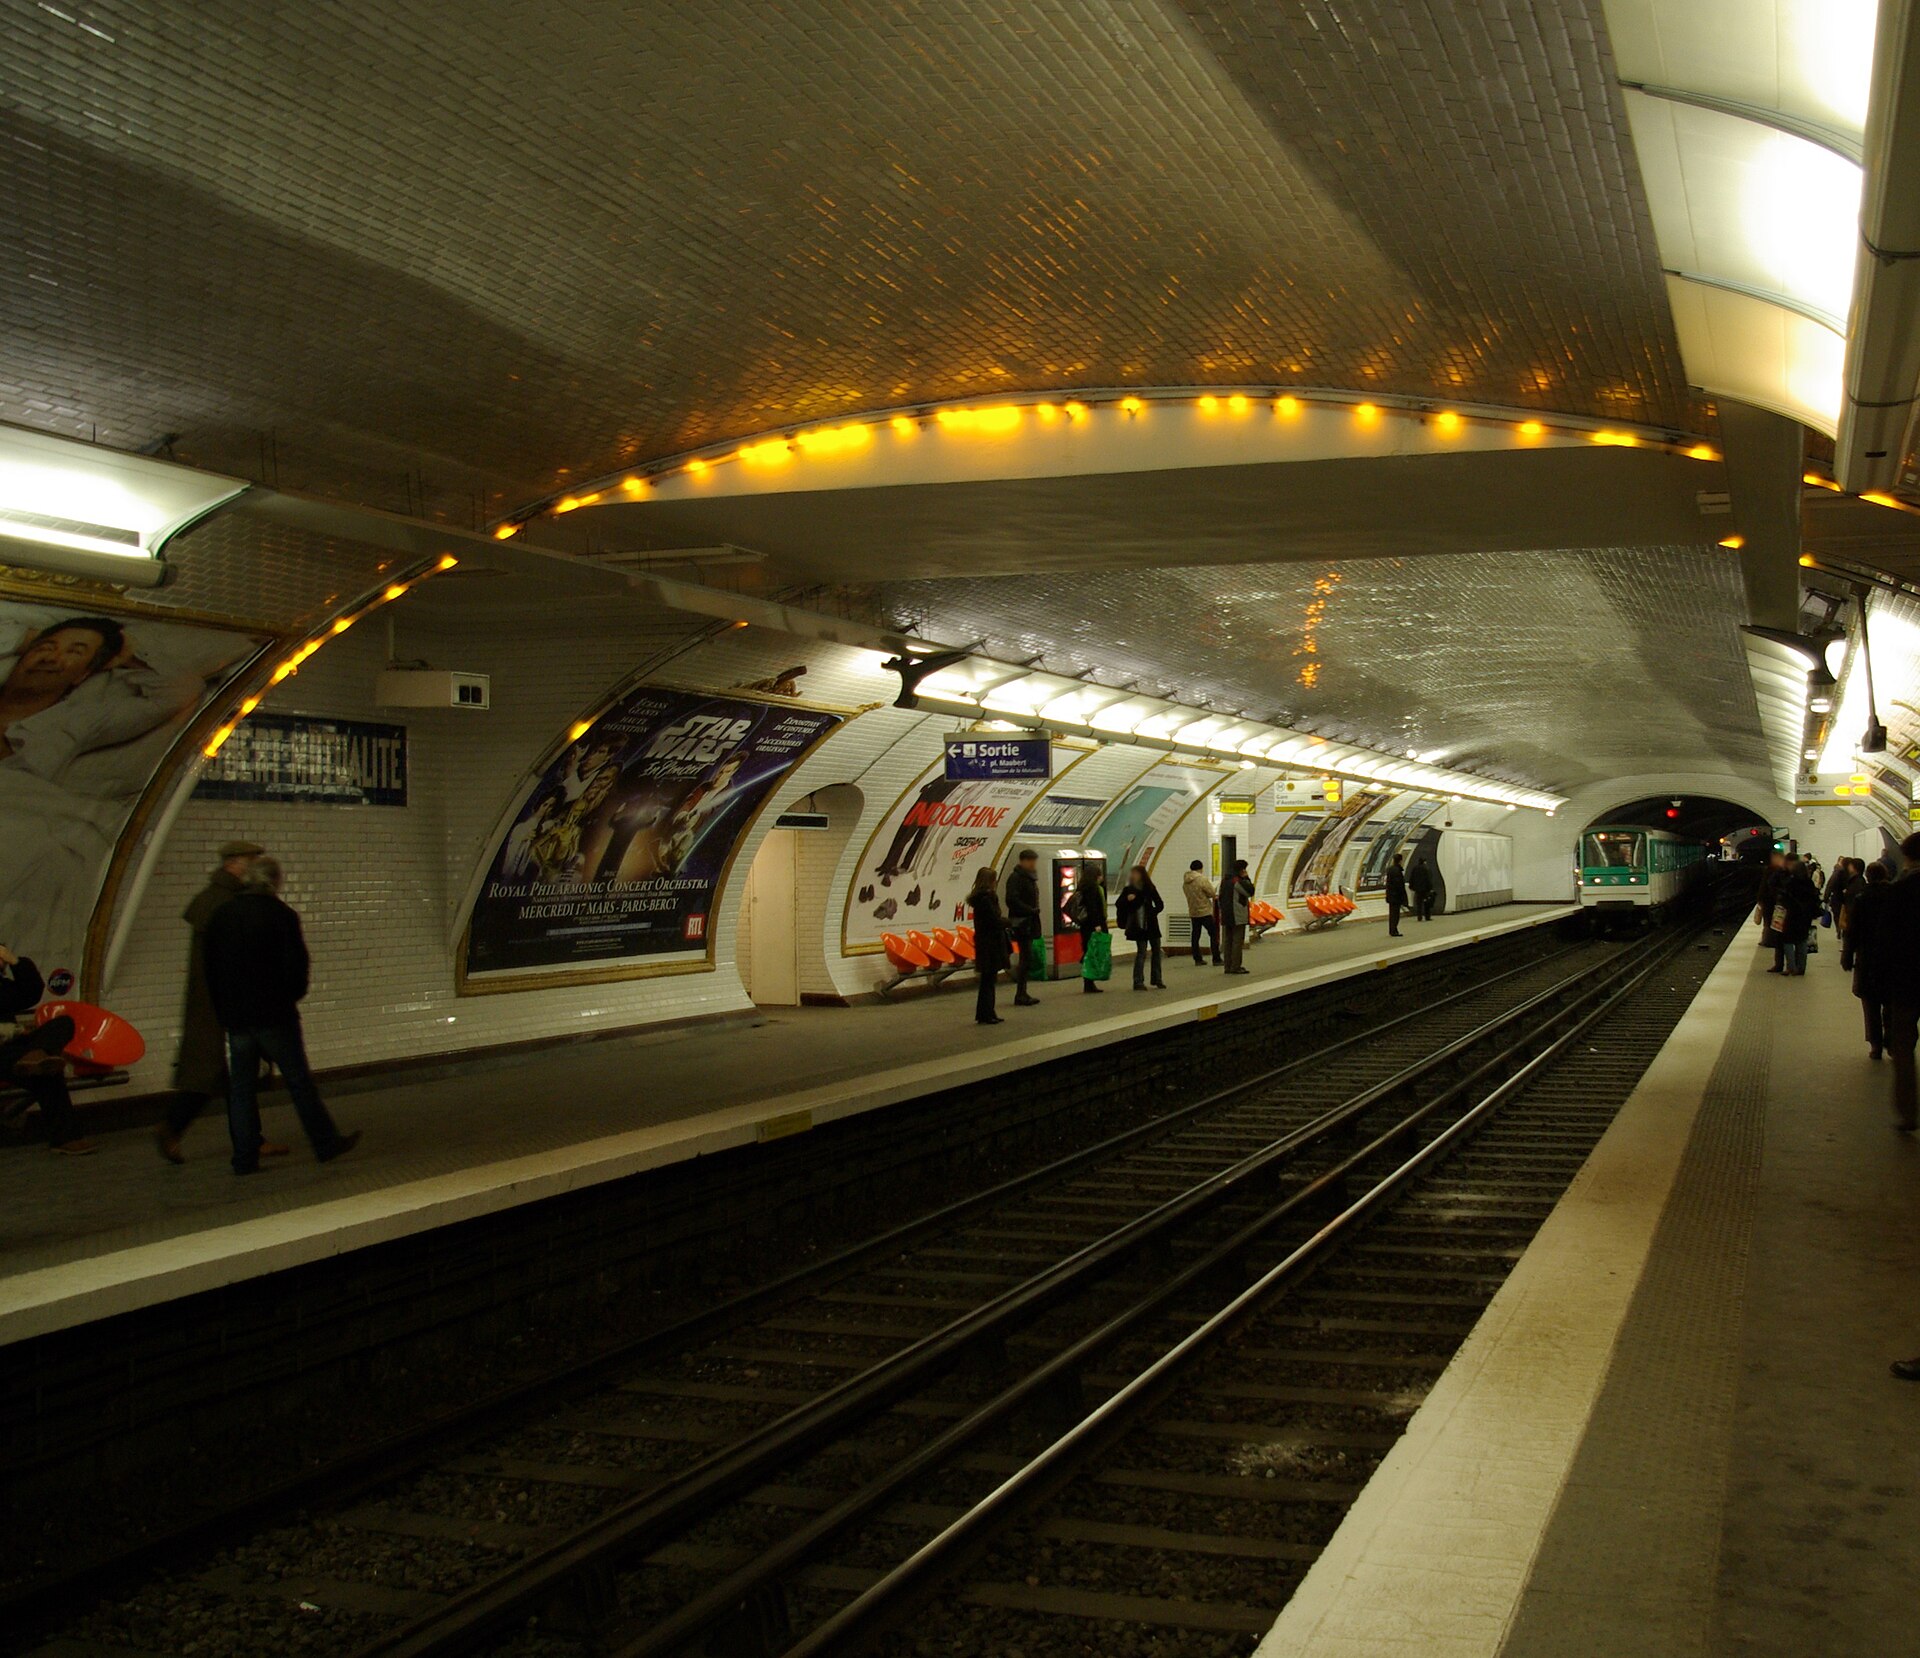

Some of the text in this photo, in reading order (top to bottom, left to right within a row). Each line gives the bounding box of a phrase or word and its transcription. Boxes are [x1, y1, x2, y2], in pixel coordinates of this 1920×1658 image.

[660, 714, 752, 743] STAR
[642, 735, 740, 763] WARS
[979, 743, 1020, 757] Sortie
[903, 801, 1010, 828] INDOCHINE
[489, 882, 527, 899] ROYAL
[606, 879, 655, 893] CONCERT
[654, 876, 710, 891] ORCHESTRA
[518, 904, 574, 920] MERCREDI
[586, 900, 616, 916] MARS
[621, 896, 680, 913] PARIS-BERCY
[687, 917, 703, 937] RTL
